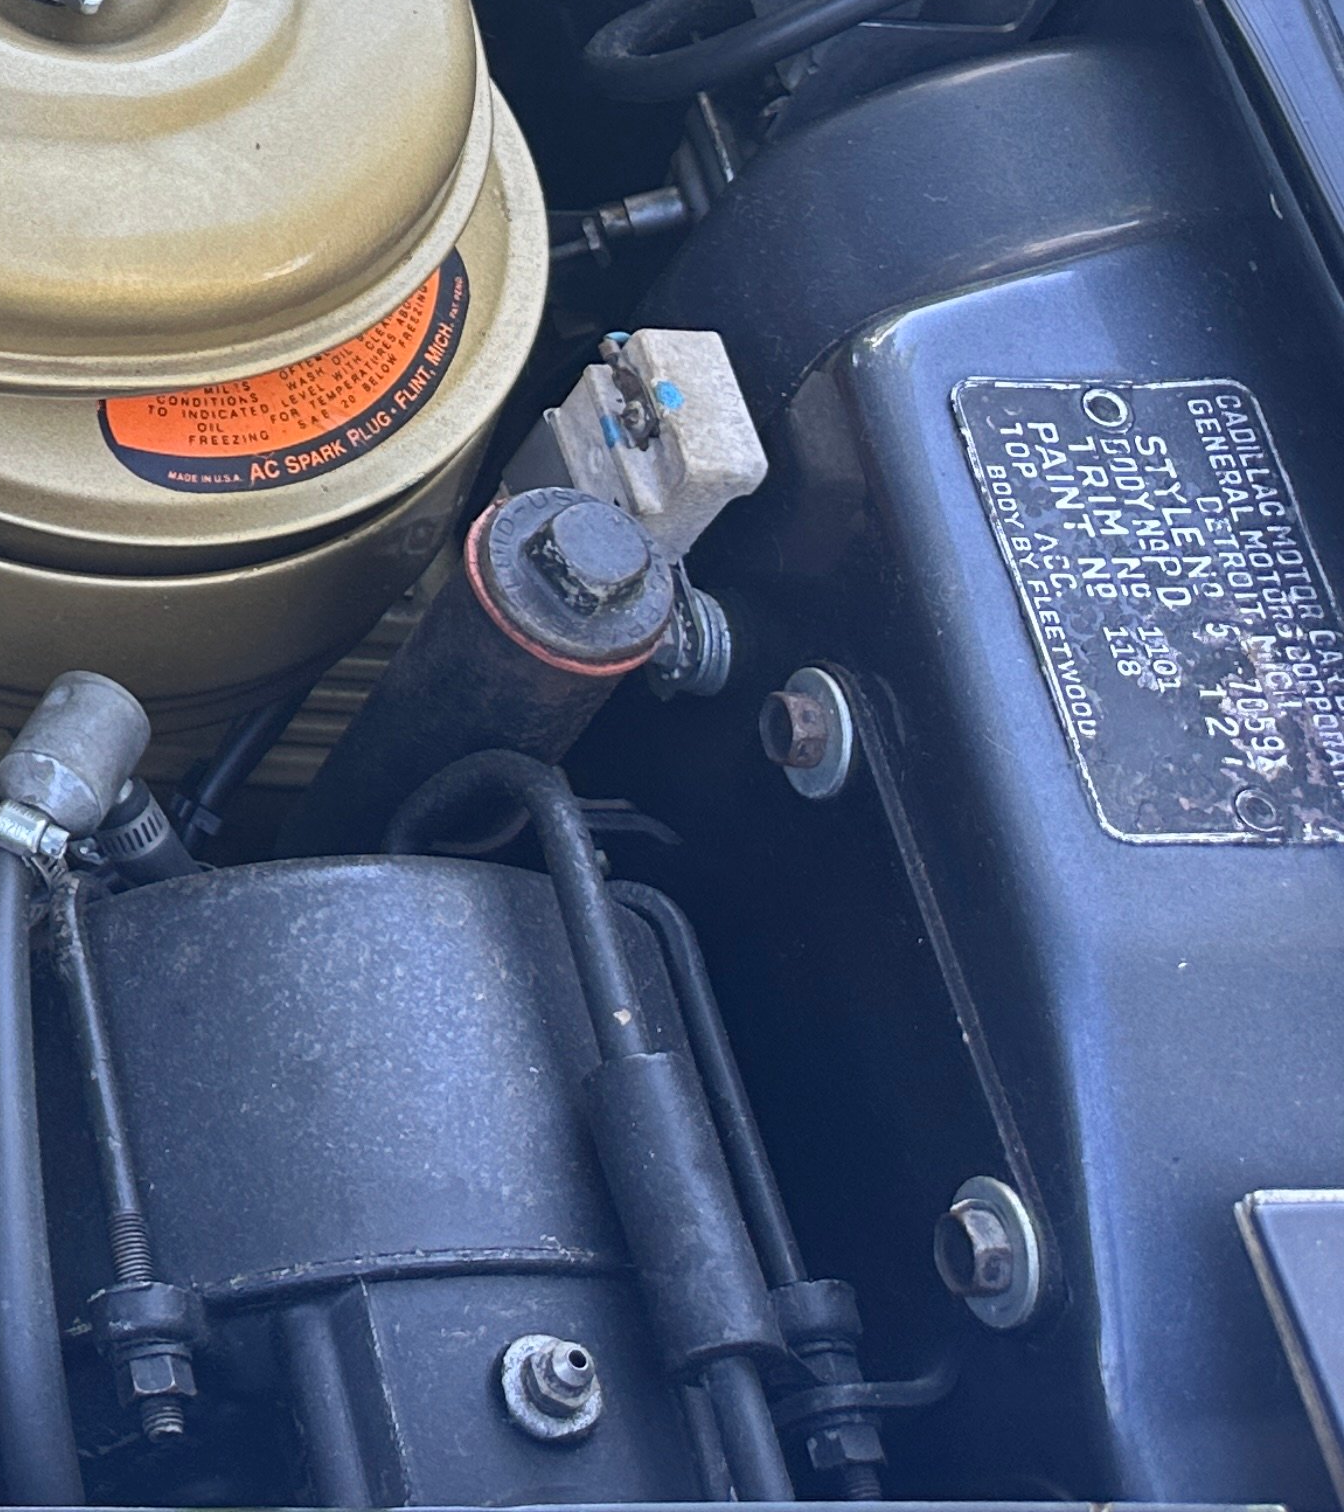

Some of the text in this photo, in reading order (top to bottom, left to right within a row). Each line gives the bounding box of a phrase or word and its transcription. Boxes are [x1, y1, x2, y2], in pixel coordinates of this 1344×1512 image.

[148, 404, 168, 417] TO
[181, 403, 270, 420] INDICATED
[281, 383, 325, 408] LEVEL
[332, 354, 362, 381] WITH
[167, 470, 197, 483] MADE
[201, 474, 212, 483] IN
[250, 459, 281, 483] AC
[284, 439, 348, 474] SPARK
[345, 410, 392, 448] PLUG
[393, 364, 437, 410] FLINT,
[424, 321, 455, 367] MICH.
[188, 430, 270, 446] FREEZING
[297, 408, 330, 429] SAE
[340, 394, 357, 409] 20
[361, 352, 398, 392] BELOW
[197, 422, 225, 433] OIL
[269, 407, 300, 425] FOR
[310, 332, 397, 409] TEMPERATURES
[286, 367, 325, 391] WASH
[331, 347, 353, 366] OIL
[999, 421, 1038, 479] TOP
[1134, 434, 1207, 549] STYLE
[1187, 398, 1254, 522] GENERAL
[1215, 394, 1285, 516] CADILLAC
[1266, 525, 1325, 619] MOTOR
[986, 464, 1097, 737] BODY BY FLEETWOOD
[1026, 421, 1096, 538] PAINT
[1102, 626, 1143, 677] 118
[1067, 435, 1130, 535] TRIM
[1136, 626, 1182, 694] 1101
